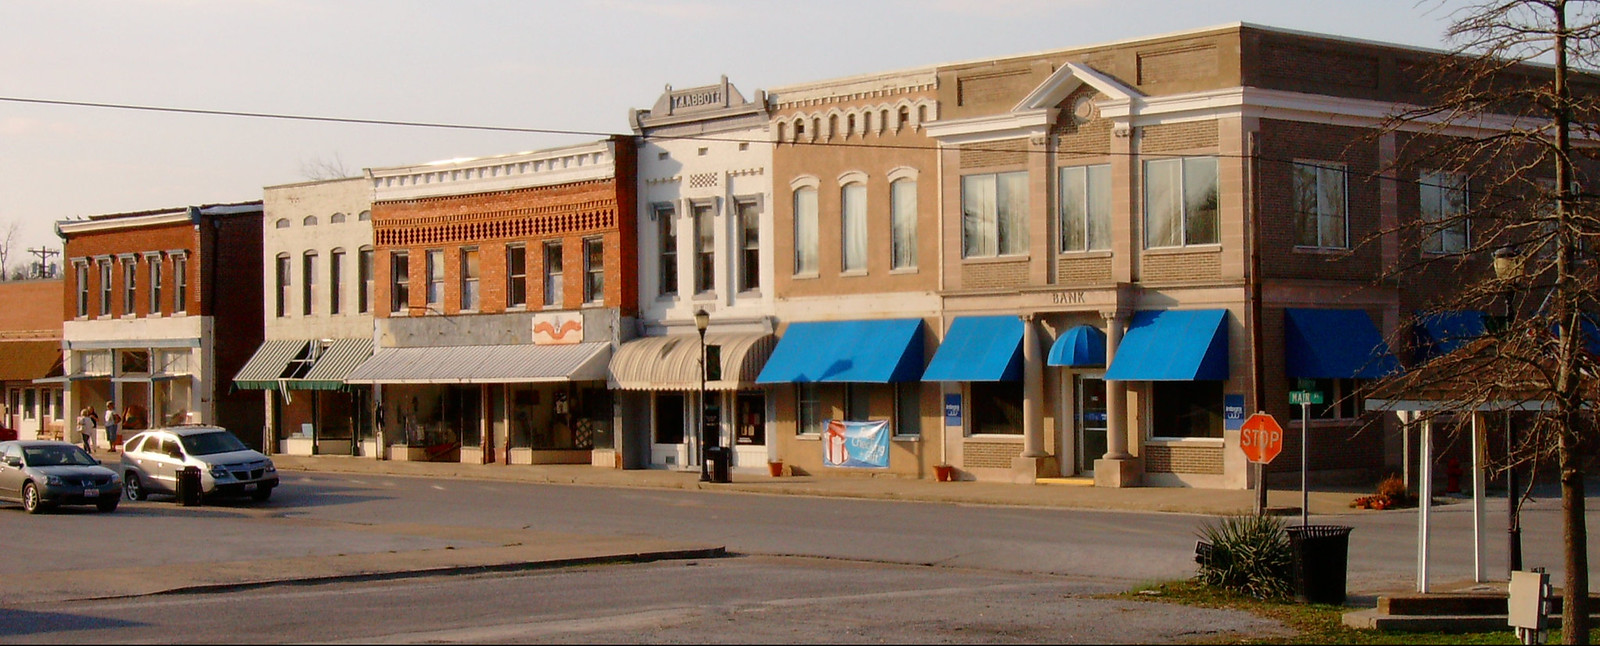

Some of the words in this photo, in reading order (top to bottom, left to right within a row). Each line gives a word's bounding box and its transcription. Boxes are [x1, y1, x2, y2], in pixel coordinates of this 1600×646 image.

[1053, 291, 1085, 304] BANK
[1291, 392, 1310, 402] MAIN
[1242, 428, 1280, 449] STOP
